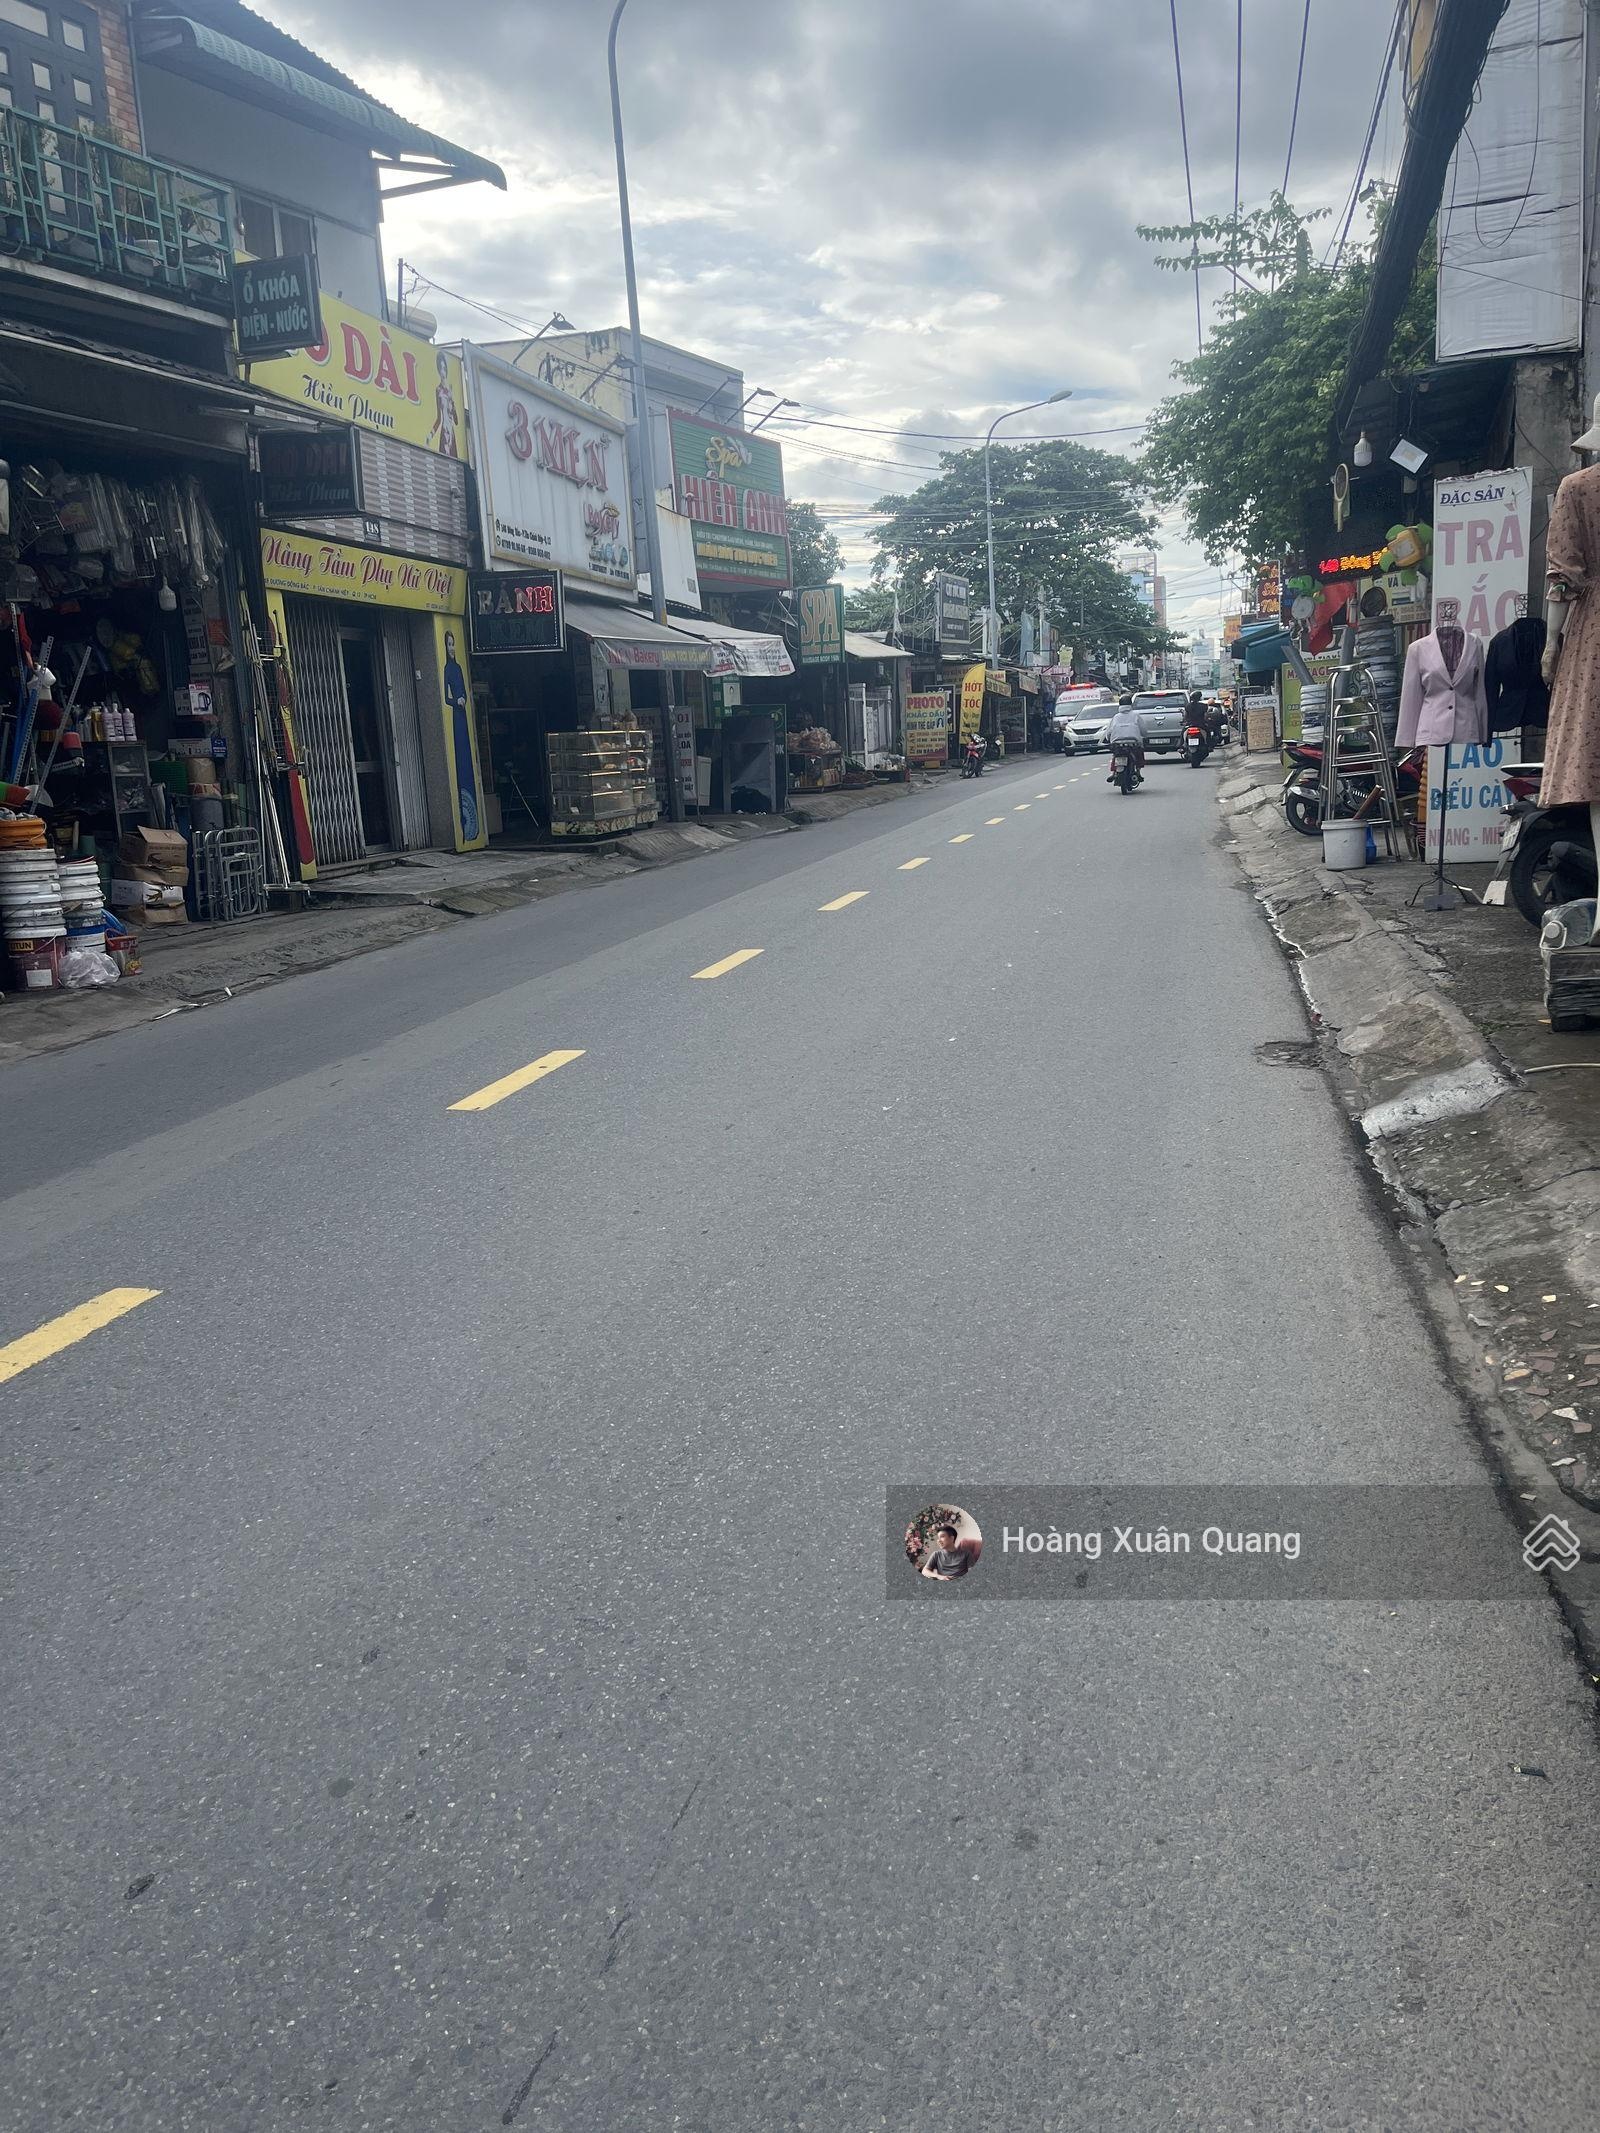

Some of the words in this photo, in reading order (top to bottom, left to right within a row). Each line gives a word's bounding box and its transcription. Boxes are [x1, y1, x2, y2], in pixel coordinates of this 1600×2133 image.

[243, 270, 253, 303] Ổ
[257, 271, 301, 302] KHÓA
[242, 307, 268, 341] ĐIỆN
[276, 302, 309, 334] NƯỚC
[340, 322, 421, 405] DÀI
[302, 374, 344, 411] Hiền
[348, 393, 395, 431] Phạm
[504, 400, 533, 460] 3
[743, 488, 787, 537] ANH
[1439, 489, 1471, 508] ĐẶC
[1473, 485, 1505, 503] SẢN
[1437, 503, 1524, 566] TRÀ
[477, 581, 554, 615] BÁNH
[801, 588, 840, 643] SPA
[907, 696, 944, 710] PHOTO
